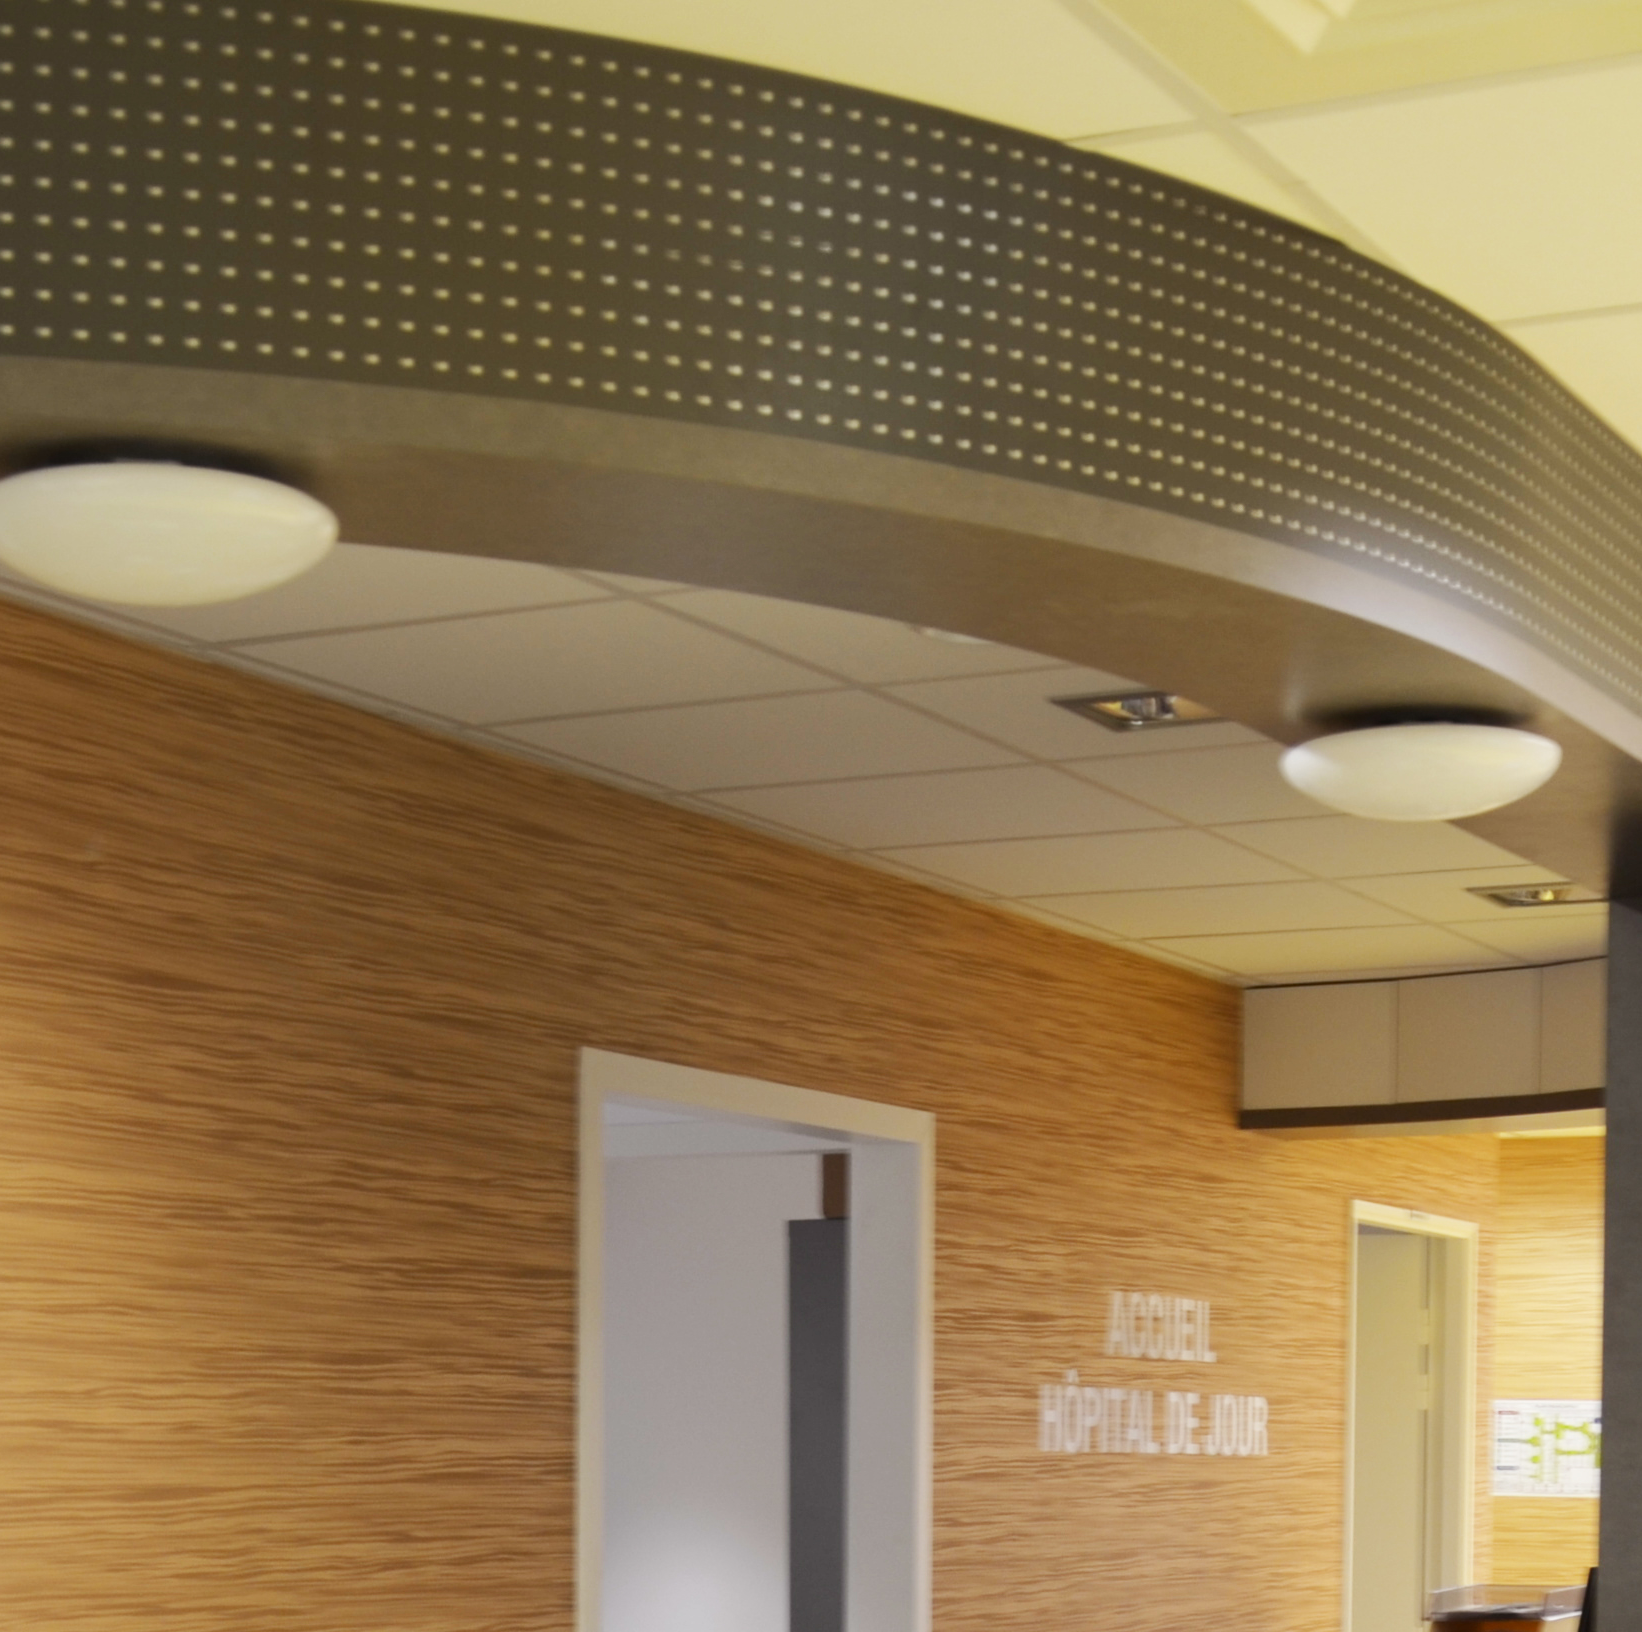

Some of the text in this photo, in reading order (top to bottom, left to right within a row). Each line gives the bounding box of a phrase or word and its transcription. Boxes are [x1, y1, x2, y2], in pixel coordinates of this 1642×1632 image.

[1105, 1291, 1217, 1363] ACCUEIL
[1038, 1368, 1268, 1457] HÔPITAL DE JOUR
